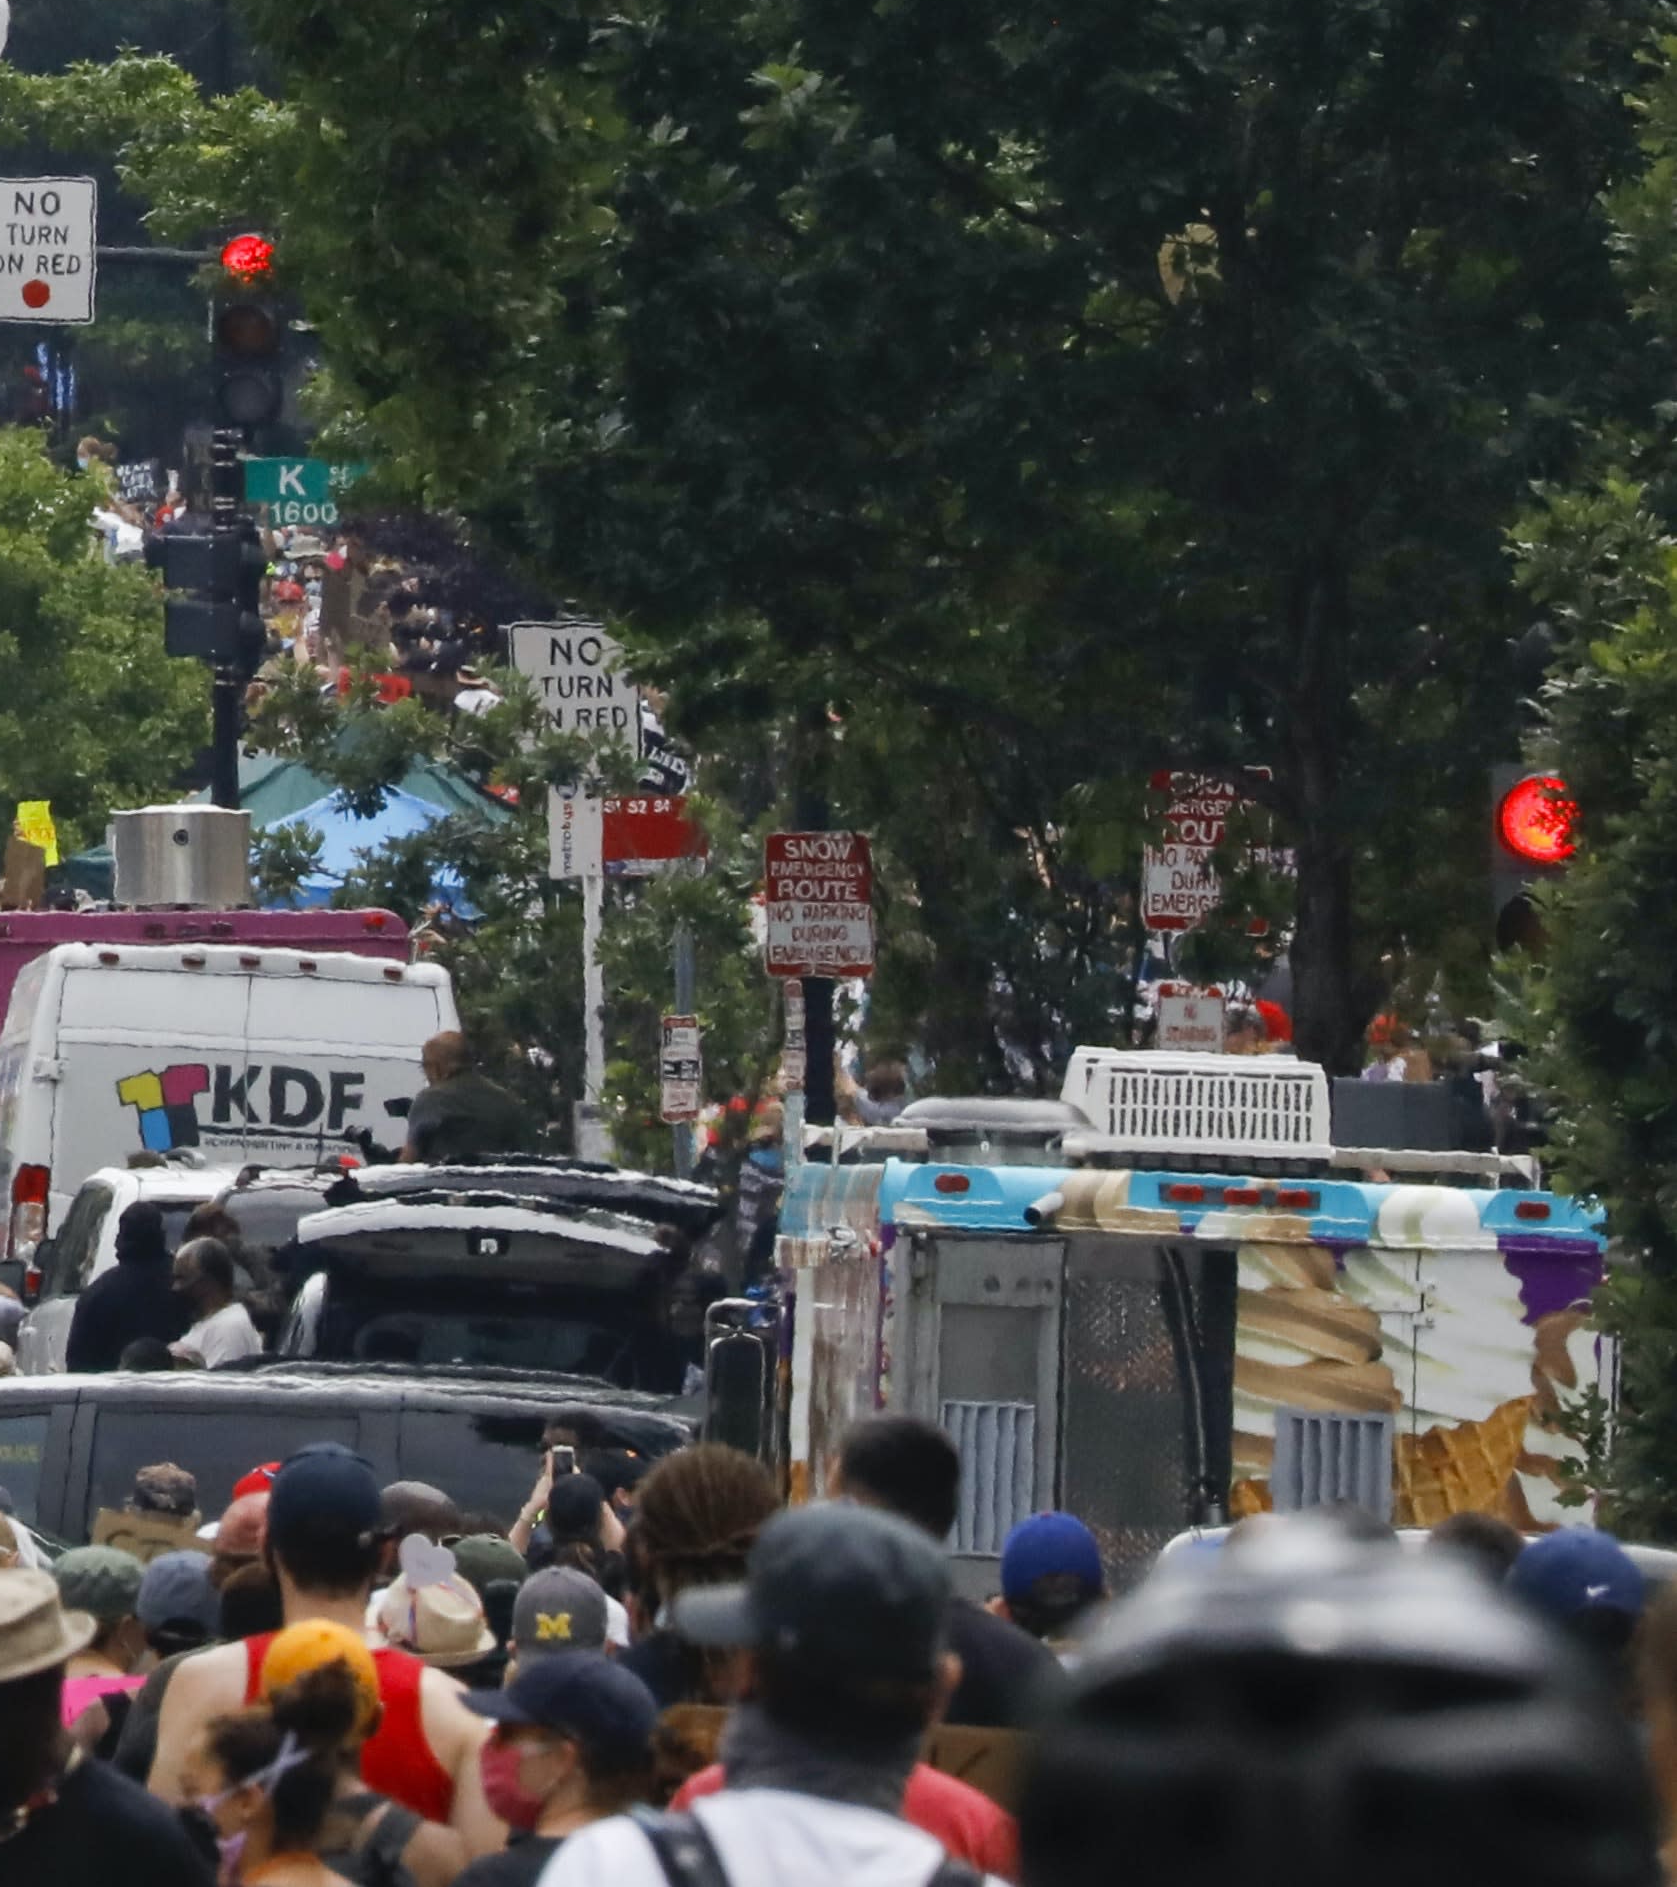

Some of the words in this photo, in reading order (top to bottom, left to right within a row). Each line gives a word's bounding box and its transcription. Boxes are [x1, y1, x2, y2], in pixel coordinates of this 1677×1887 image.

[14, 191, 61, 216] NO
[6, 223, 69, 246] TURN
[36, 253, 81, 275] RED
[279, 464, 306, 496] K
[270, 502, 339, 524] 1600
[549, 636, 602, 666] NO
[541, 675, 613, 699] TURN
[547, 706, 563, 729] N
[575, 707, 628, 730] RED
[627, 799, 647, 814] S2
[783, 838, 853, 860] SNOW
[770, 863, 865, 879] EMERGENCY
[777, 880, 859, 901] ROUTE
[771, 905, 794, 923] NO
[802, 903, 870, 923] PARKING
[791, 925, 848, 942] DURING
[771, 944, 866, 964] EMERGENCY
[212, 1064, 365, 1131] KDF
[535, 1612, 573, 1641] M
